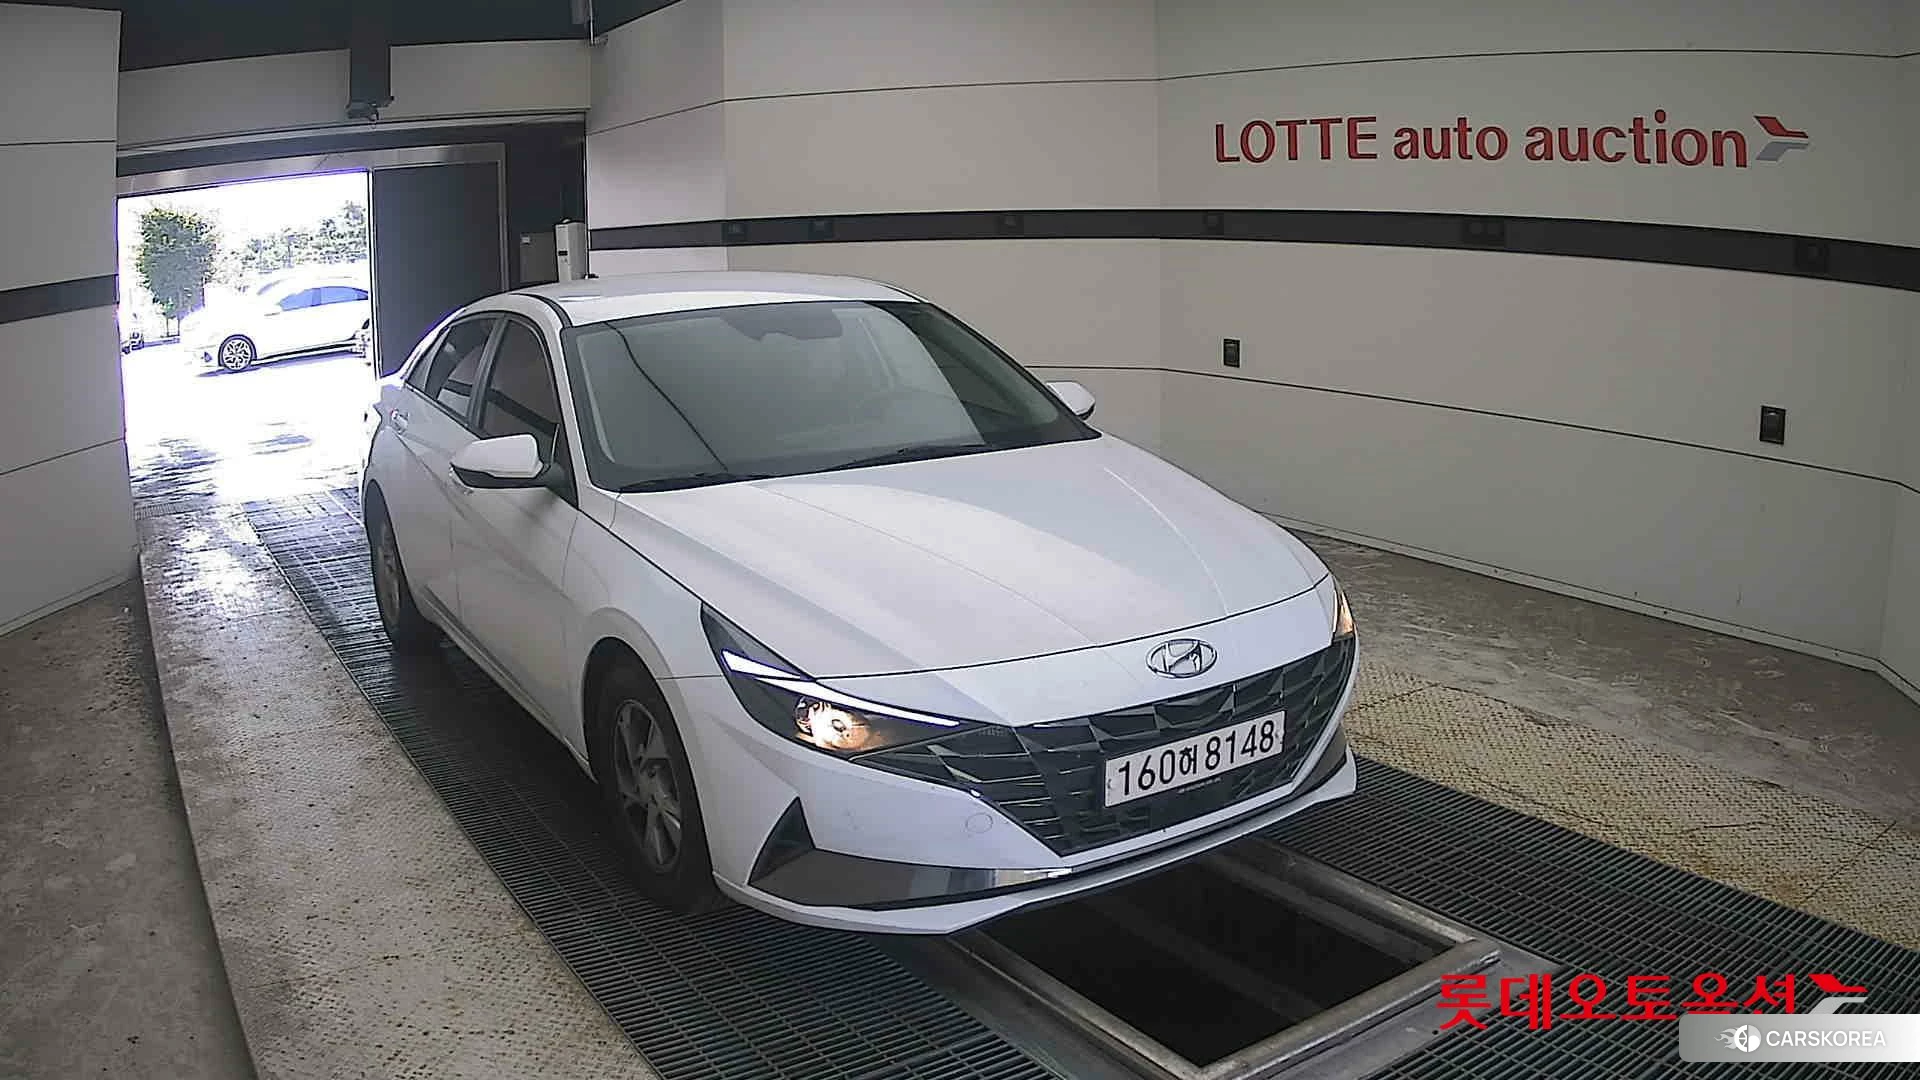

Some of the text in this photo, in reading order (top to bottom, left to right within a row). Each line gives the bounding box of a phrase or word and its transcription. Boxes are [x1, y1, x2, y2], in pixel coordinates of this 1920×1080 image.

[1215, 109, 1748, 168] LOTTE auto auction
[1204, 719, 1275, 771] 8148
